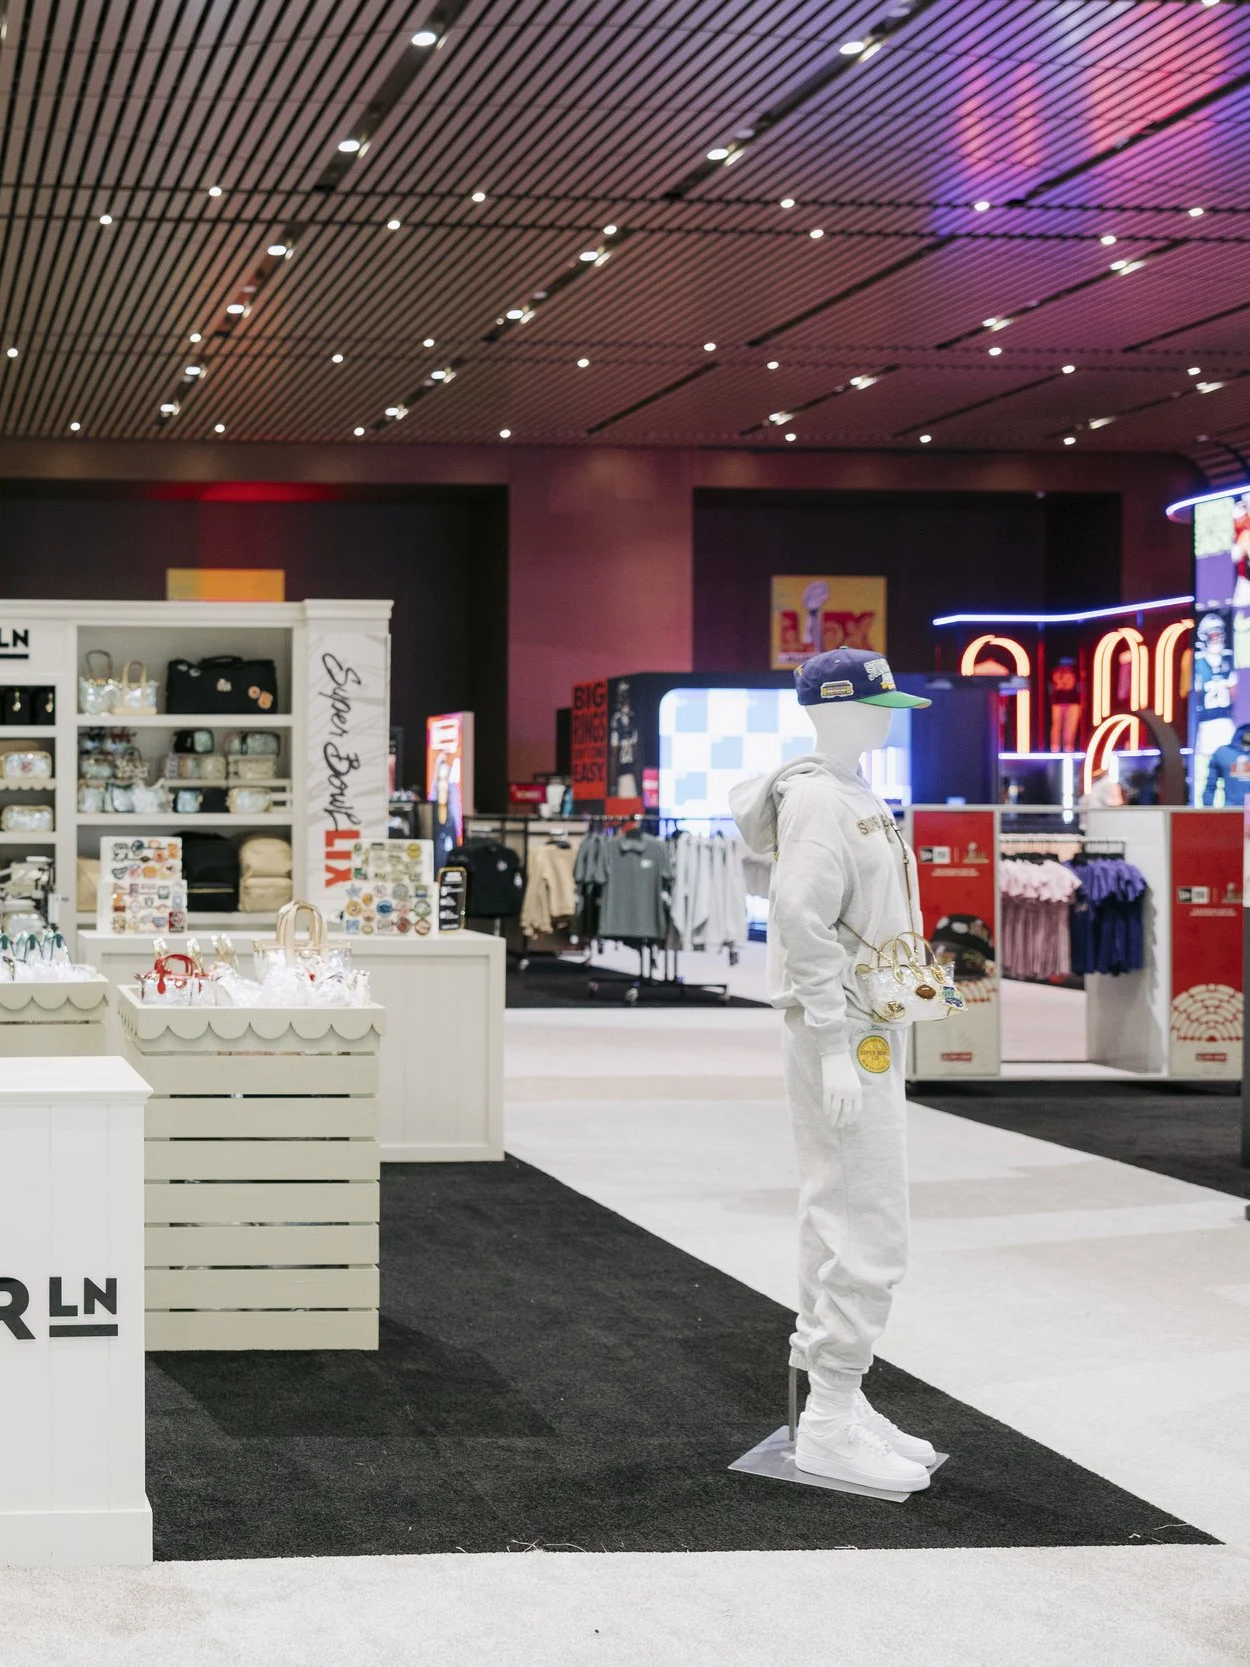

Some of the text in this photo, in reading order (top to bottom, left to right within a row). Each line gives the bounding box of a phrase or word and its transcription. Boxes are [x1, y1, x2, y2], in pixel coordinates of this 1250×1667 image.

[573, 683, 606, 710] BIG
[318, 653, 362, 888] Super Bowl LIX
[49, 1276, 117, 1318] LN
